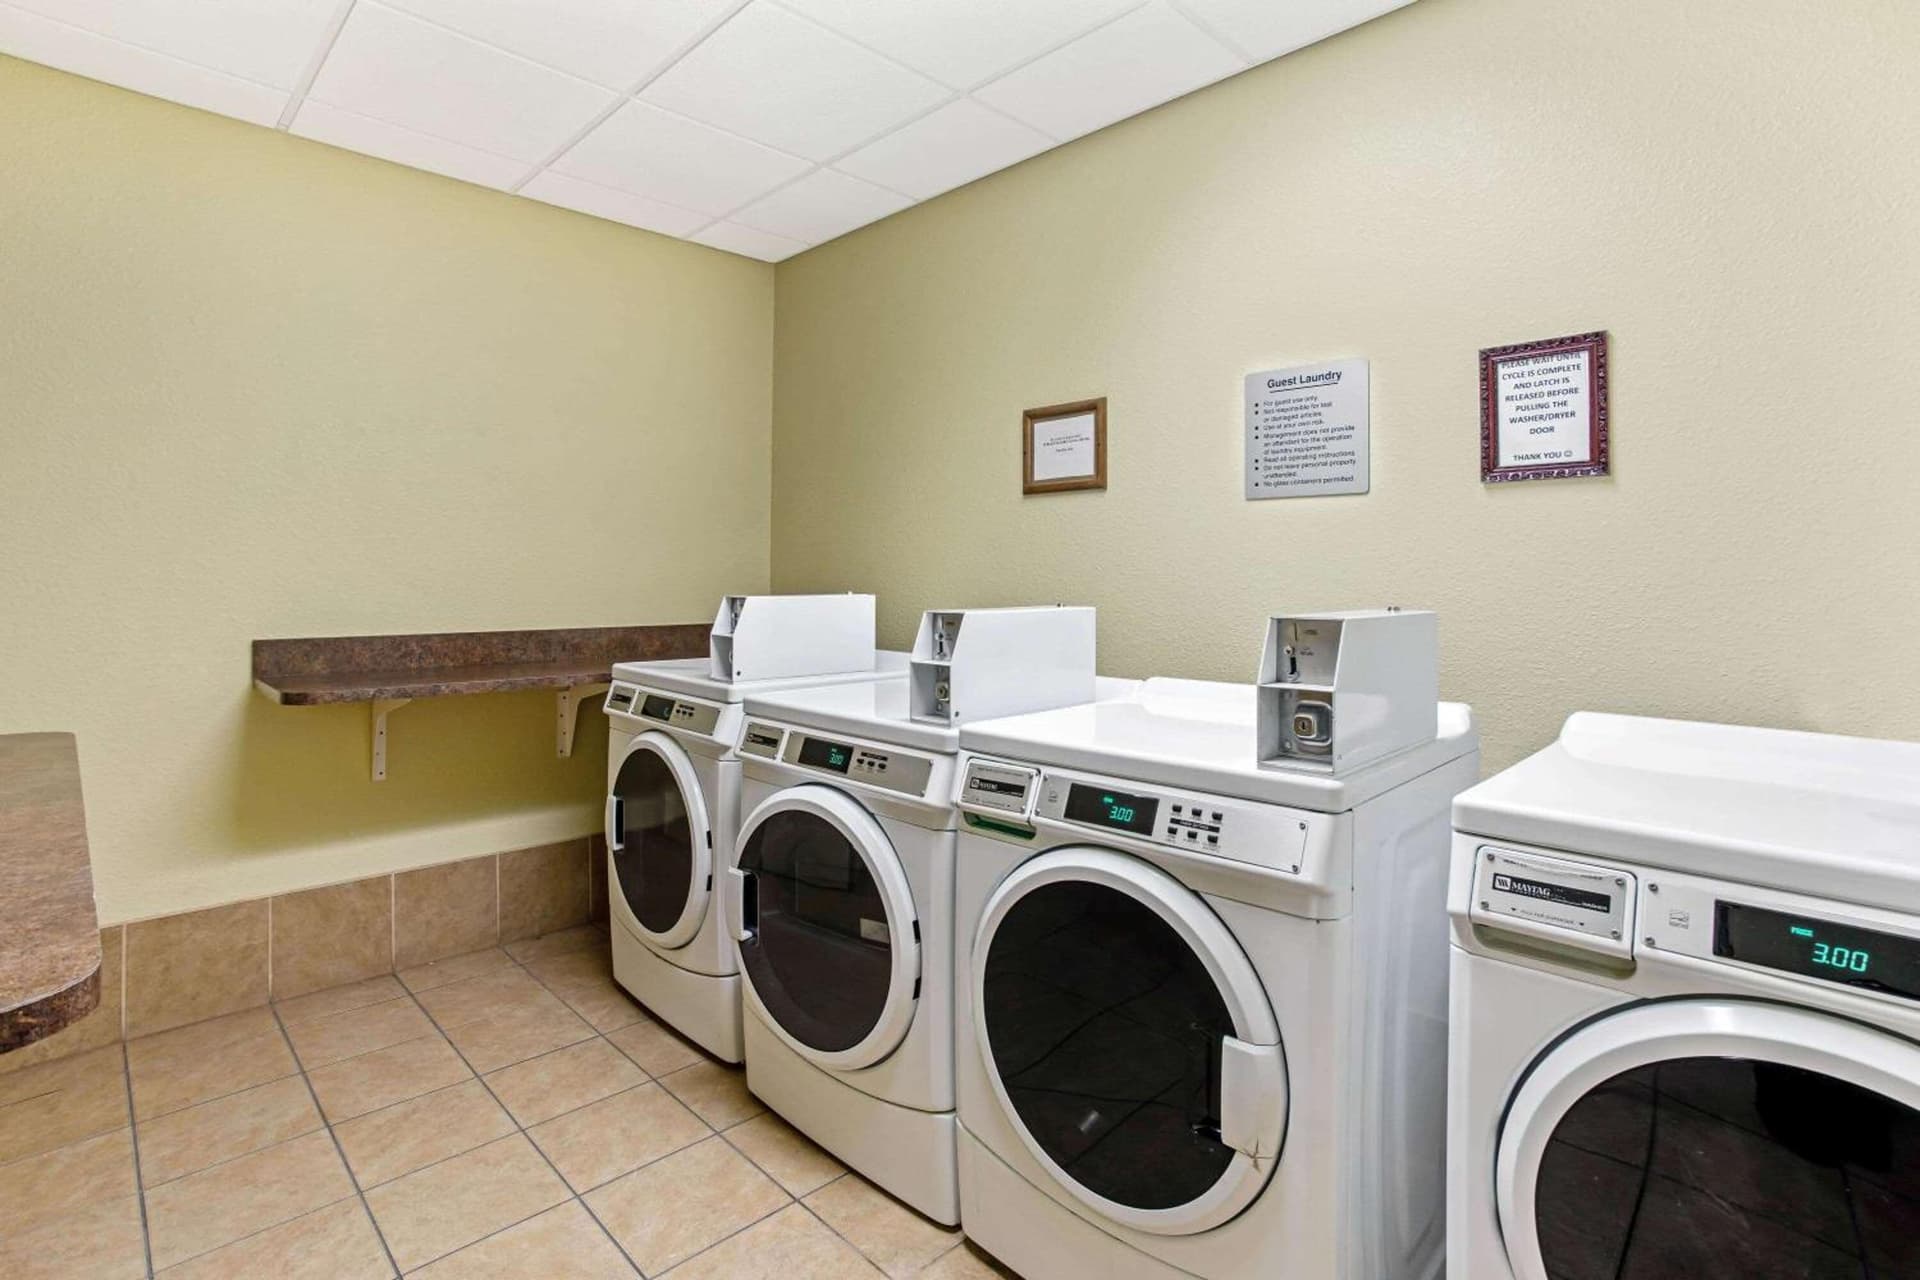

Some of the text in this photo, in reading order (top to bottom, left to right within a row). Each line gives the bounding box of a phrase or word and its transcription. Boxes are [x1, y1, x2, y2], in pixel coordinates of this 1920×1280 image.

[1501, 352, 1581, 369] PLEASE WAIT UNTIL
[1502, 363, 1582, 380] CYCLE IS COMPLETE
[1267, 370, 1342, 389] Guest Laundry
[1513, 382, 1532, 390] AND
[1533, 377, 1560, 388] LATCH
[1505, 387, 1579, 402] RELEASED BEFORE
[1515, 400, 1568, 412] PULLING THE
[1508, 410, 1576, 424] WASHER/DRYER
[1263, 430, 1301, 439] Management
[1331, 425, 1355, 433] provide
[1529, 426, 1555, 435] DOOR
[1322, 435, 1352, 443] operation
[1513, 450, 1562, 461] THANK YOU
[1301, 461, 1328, 469] personal
[1109, 806, 1134, 822] 3.00
[1511, 881, 1551, 897] MAYTAG
[1812, 943, 1869, 973] 3.00
